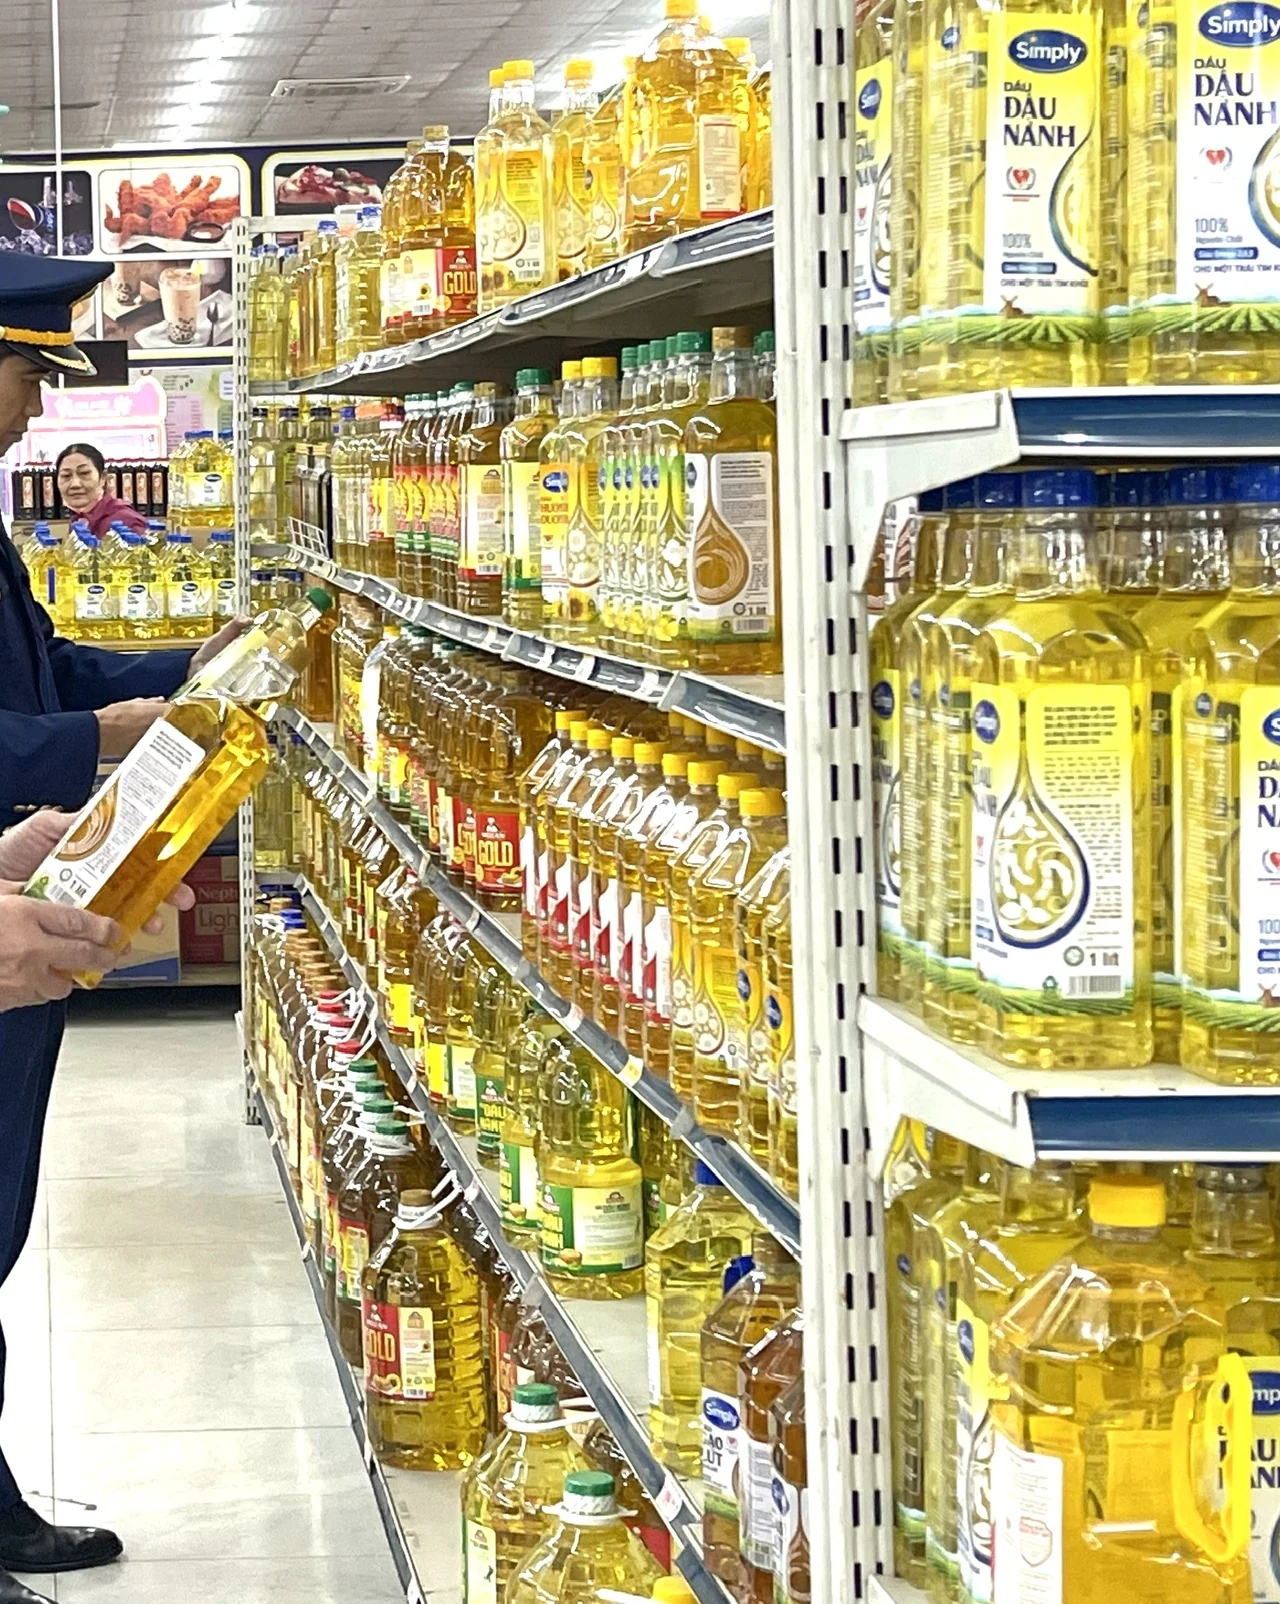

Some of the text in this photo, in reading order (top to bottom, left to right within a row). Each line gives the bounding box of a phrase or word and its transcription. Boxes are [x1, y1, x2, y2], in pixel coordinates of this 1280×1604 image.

[1208, 9, 1280, 38] Simply
[1016, 36, 1082, 65] Simply
[1195, 218, 1229, 233] 100%
[443, 271, 477, 295] GOLD
[478, 839, 514, 867] GOLD
[201, 907, 238, 933] Ligh
